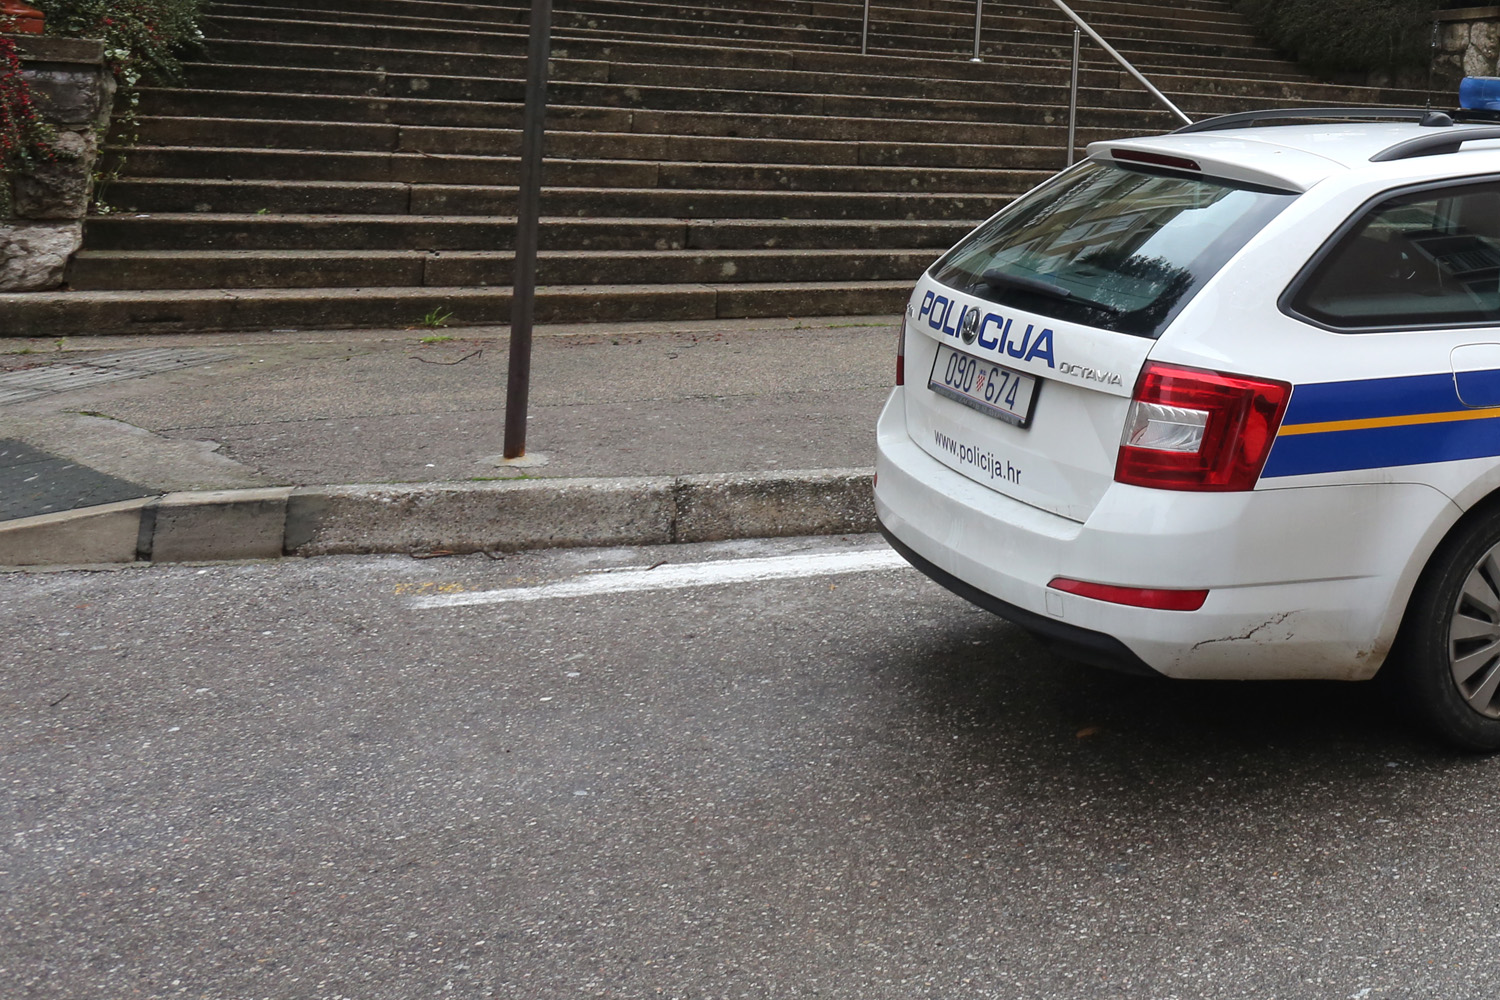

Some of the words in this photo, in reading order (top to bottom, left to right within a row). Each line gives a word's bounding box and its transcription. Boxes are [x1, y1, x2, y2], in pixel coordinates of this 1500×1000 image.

[918, 290, 1055, 369] POLICIJA
[944, 352, 977, 392] 090
[984, 366, 1019, 410] 674
[1060, 362, 1122, 386] OCTAVIA
[934, 429, 1022, 484] www.policija.hr
